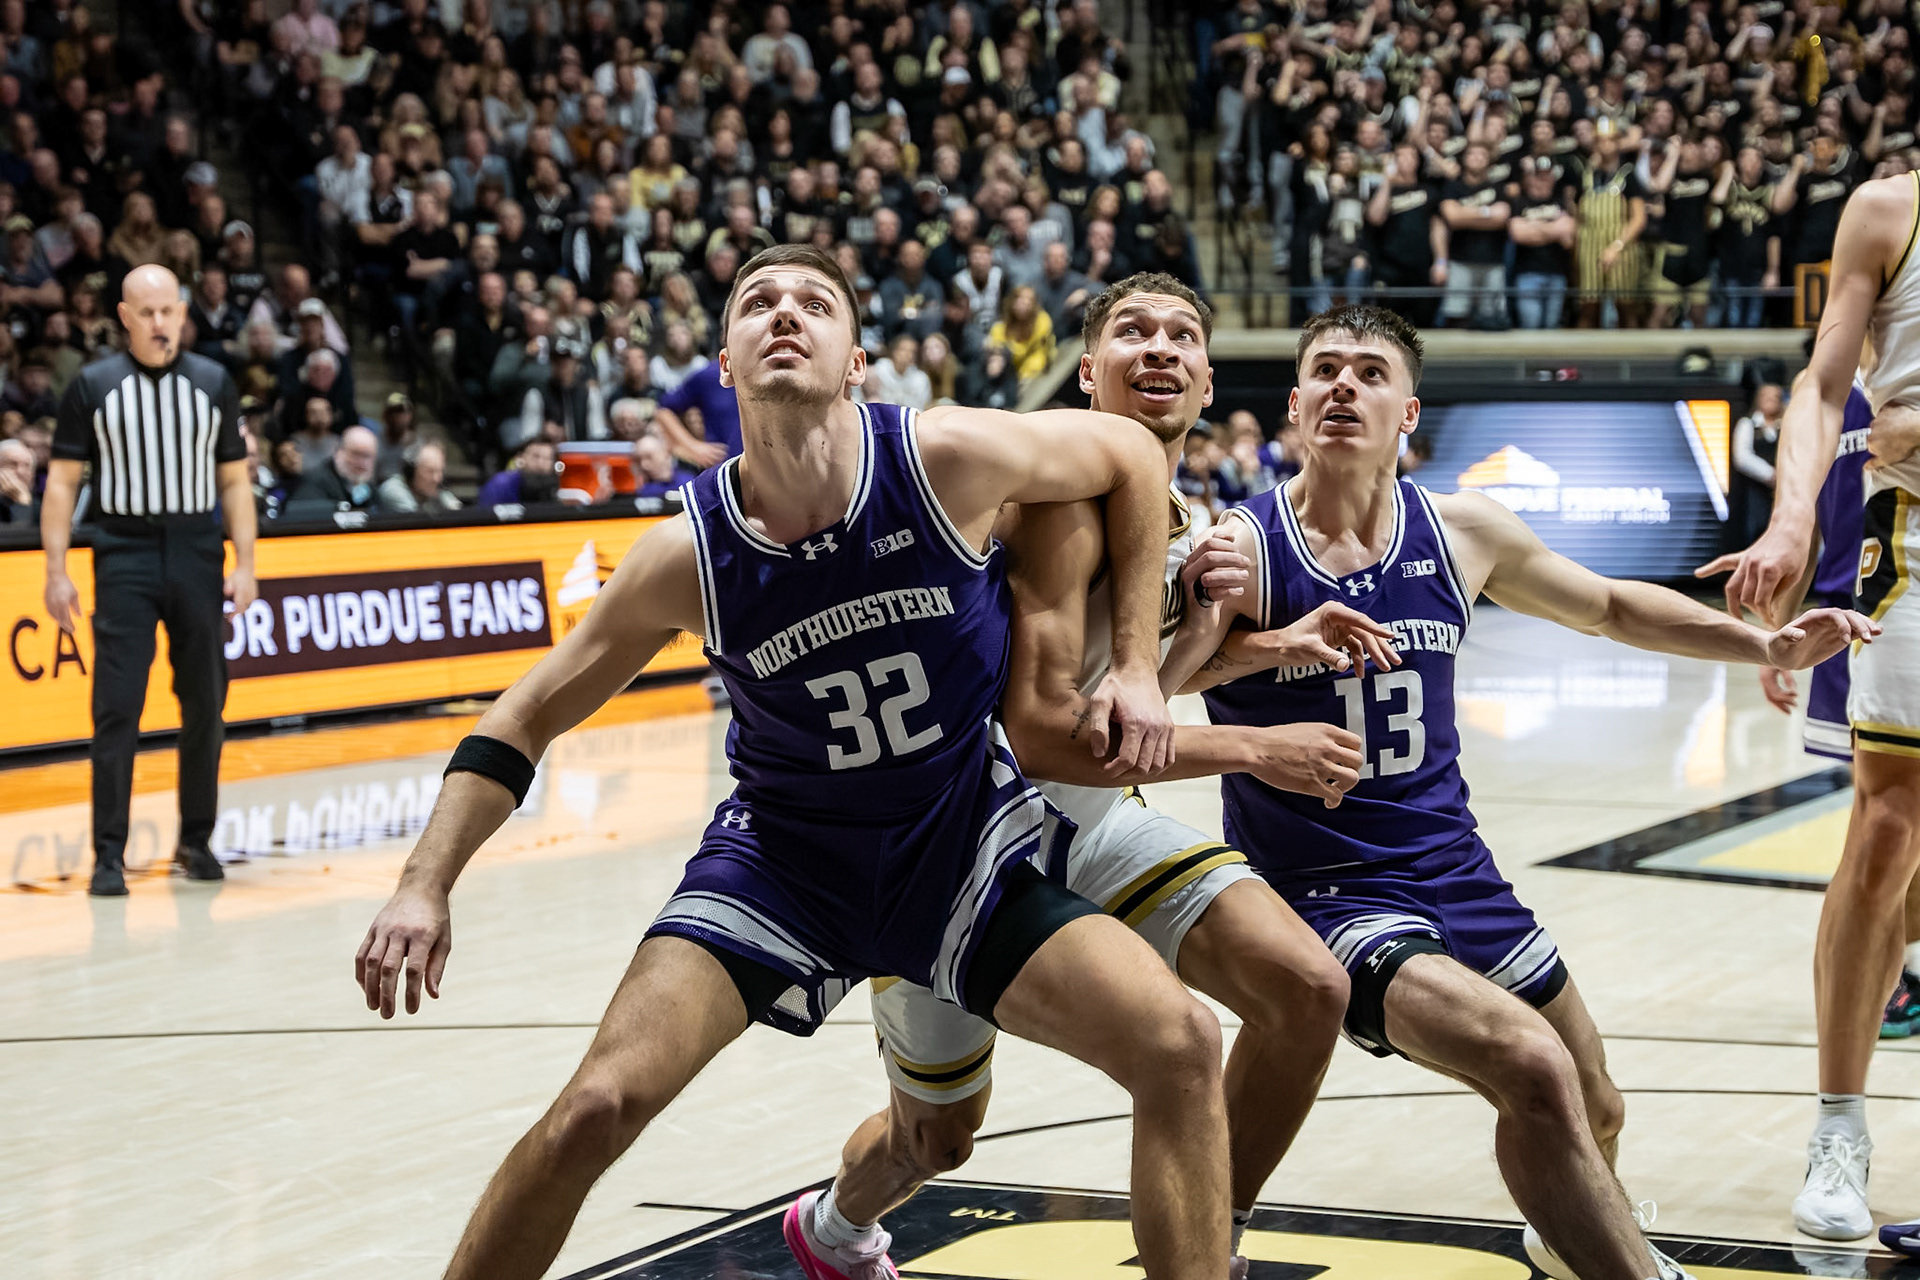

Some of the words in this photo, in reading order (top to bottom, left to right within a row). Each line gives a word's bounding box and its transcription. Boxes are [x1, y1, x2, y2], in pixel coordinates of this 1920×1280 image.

[282, 584, 446, 654] PURDUE
[447, 577, 545, 639] FANS
[745, 586, 956, 680] NORTHWESTERN
[804, 651, 945, 771] 32
[1333, 669, 1427, 780] 13
[948, 1206, 1018, 1222] TM
